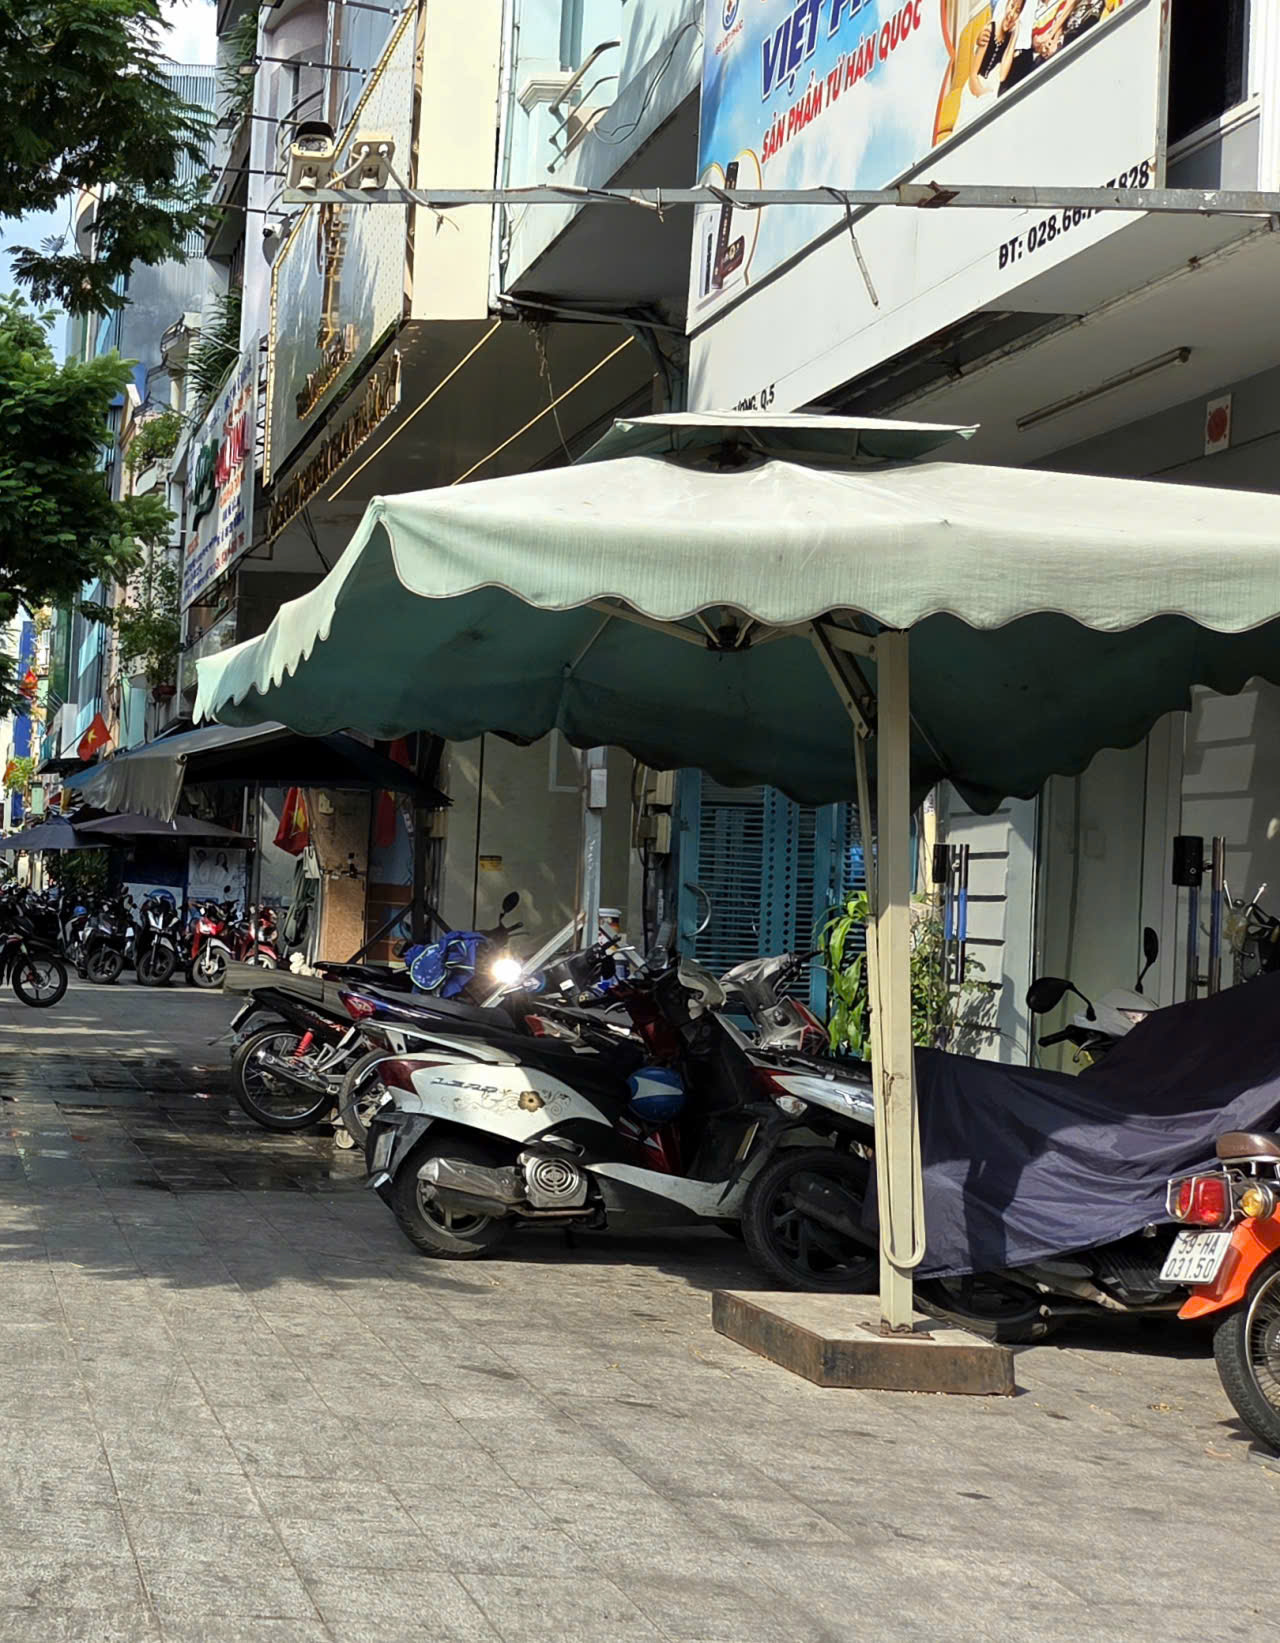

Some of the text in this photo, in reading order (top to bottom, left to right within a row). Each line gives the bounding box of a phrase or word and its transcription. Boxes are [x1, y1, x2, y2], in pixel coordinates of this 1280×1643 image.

[761, 112, 786, 164] SẢN
[787, 70, 824, 142] PHẨM
[760, 383, 775, 411] Q.5
[1165, 1258, 1216, 1279] 031.50
